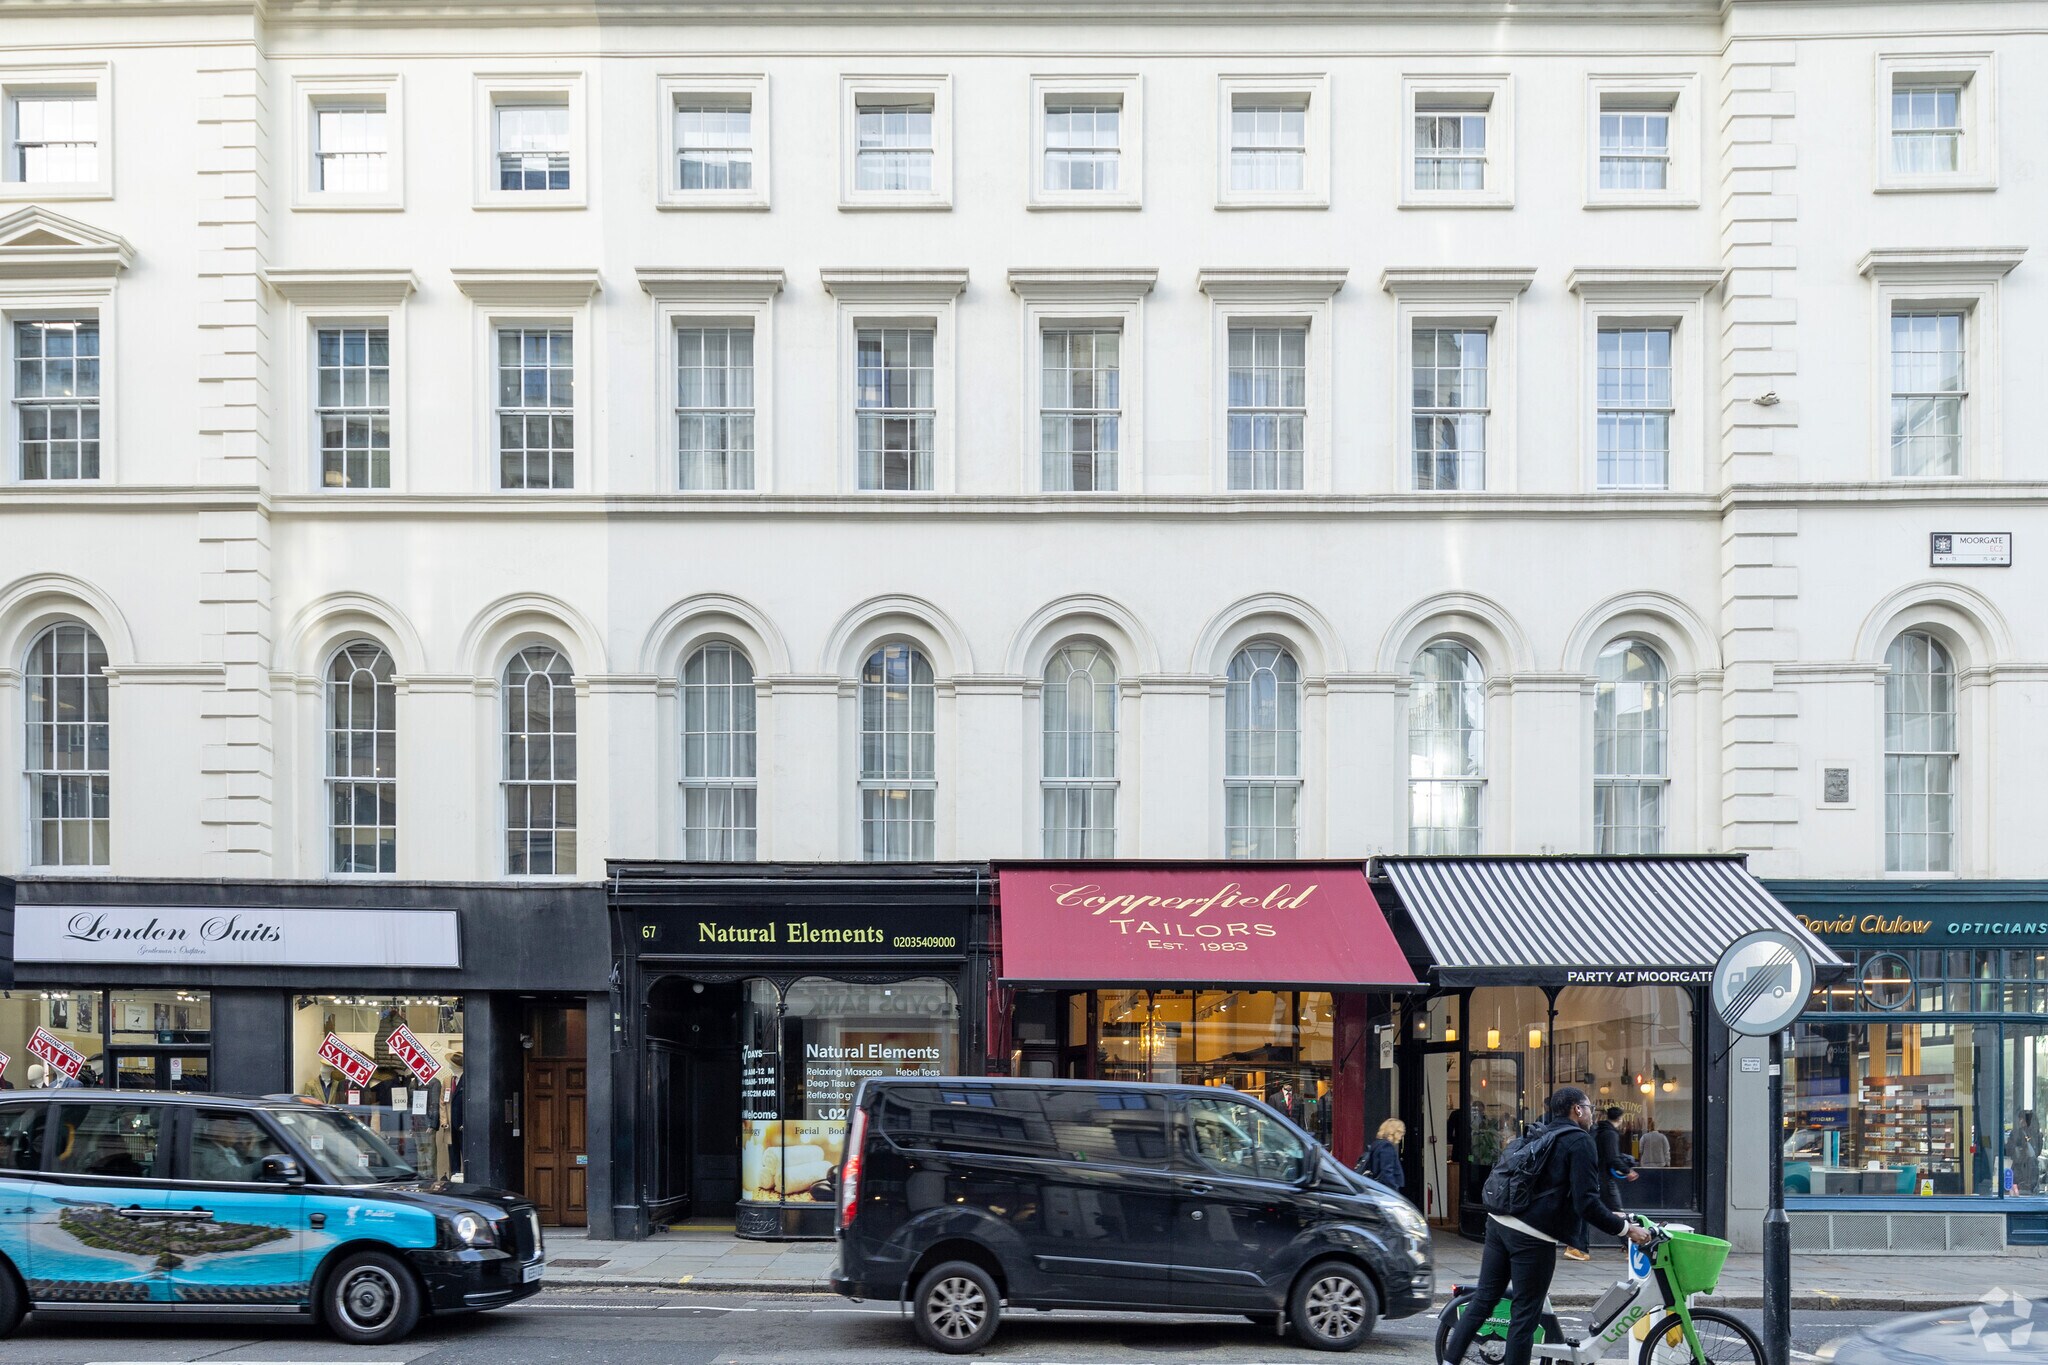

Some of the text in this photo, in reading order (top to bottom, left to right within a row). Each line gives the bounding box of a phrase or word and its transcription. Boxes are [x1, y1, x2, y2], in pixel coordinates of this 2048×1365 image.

[1959, 536, 2003, 544] MOORGATE
[1989, 545, 2003, 553] EC2
[1050, 882, 1318, 917] Copperfield
[63, 911, 280, 946] London Suits
[1109, 918, 1277, 938] TAILORS
[1796, 914, 1932, 934] David Clulow
[1947, 922, 2048, 934] OPTICIANS
[642, 925, 656, 938] 67
[698, 922, 884, 943] Natural Elements
[893, 936, 956, 948] 02035409000
[1199, 941, 1249, 951] 1983
[1567, 971, 1615, 982] PARTY
[1616, 971, 1635, 982] AT
[39, 1032, 81, 1061] CLOSING DOWN
[330, 1037, 371, 1069] CLOSING DOWN
[401, 1029, 437, 1067] CLOSING DOWN
[806, 1043, 940, 1059] Natural Elements
[30, 1037, 78, 1075] SALE
[389, 1034, 433, 1081] SALE
[748, 1050, 762, 1058] DAYS
[321, 1043, 369, 1082] SALE
[806, 1067, 842, 1077] Relaxing
[845, 1068, 882, 1077] Massage
[921, 1068, 940, 1076] Teas
[806, 1079, 855, 1088] Deep Tissue
[828, 1108, 849, 1120] 02
[795, 1127, 845, 1135] Facial Bod
